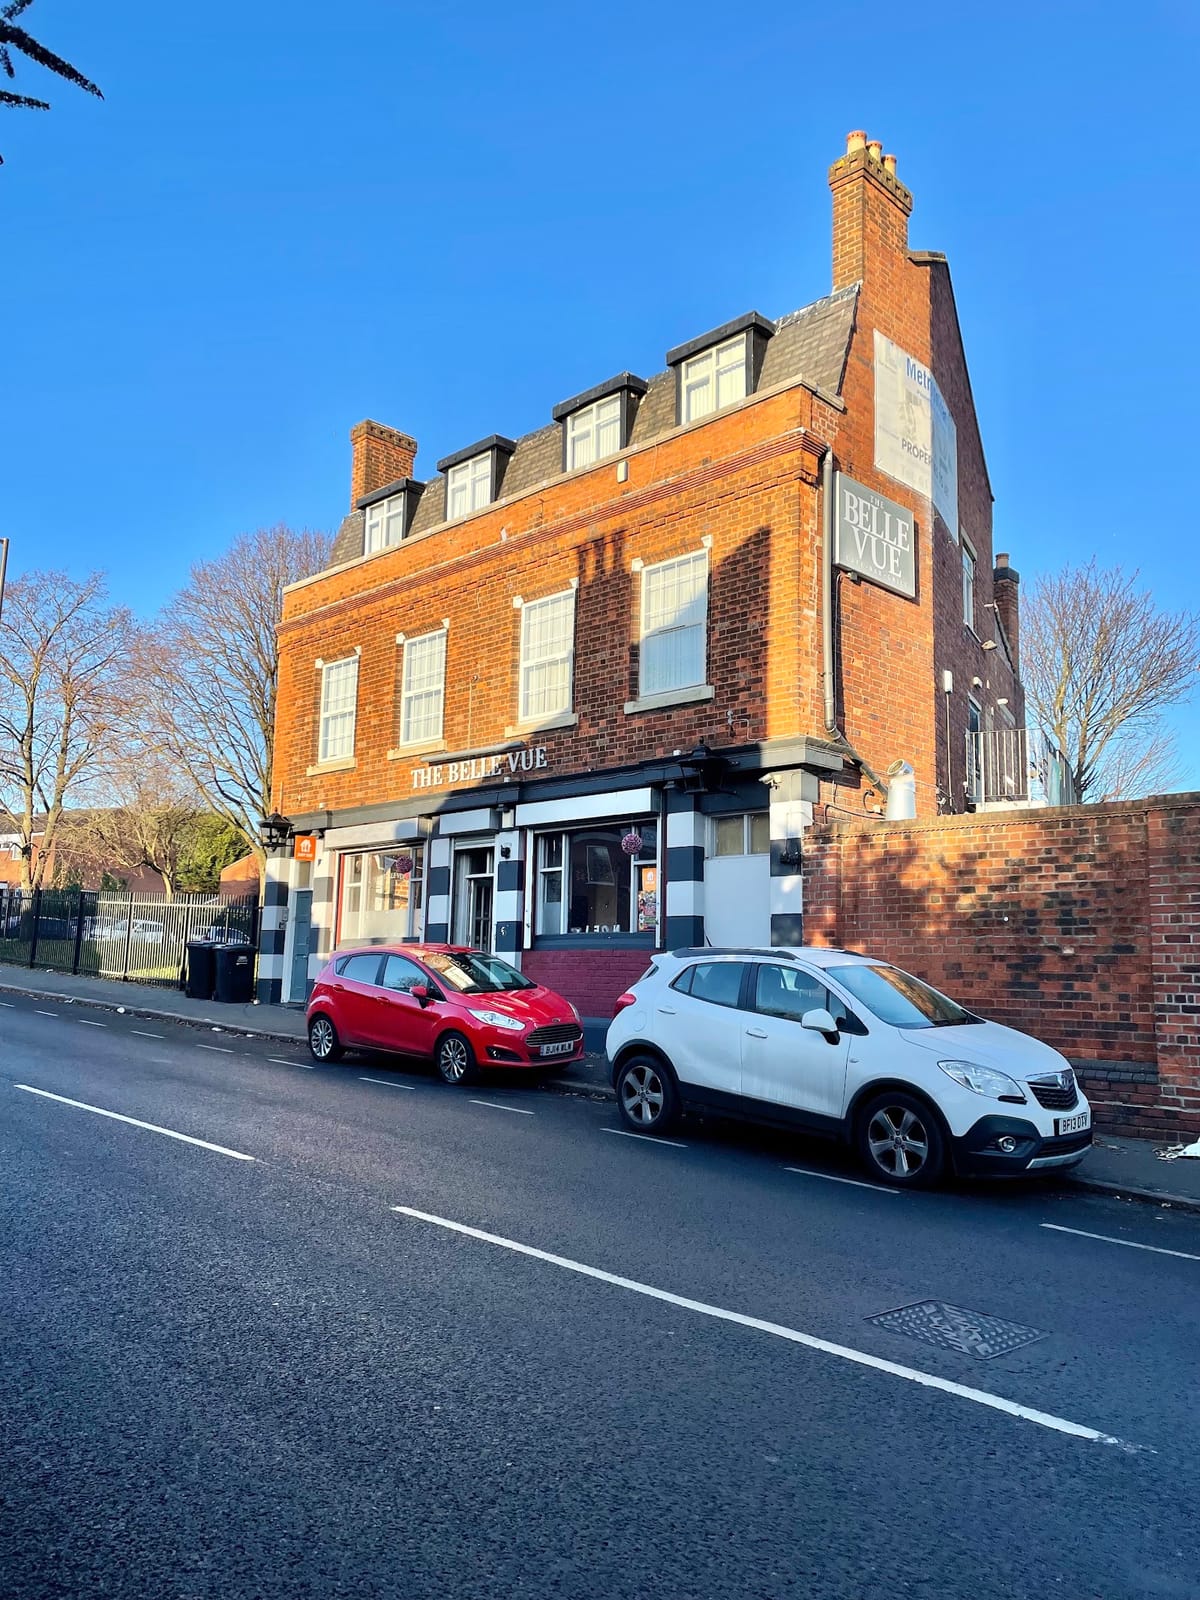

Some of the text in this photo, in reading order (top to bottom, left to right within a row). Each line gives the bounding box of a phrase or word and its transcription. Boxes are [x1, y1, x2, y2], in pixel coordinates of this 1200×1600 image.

[843, 489, 910, 552] BELLE
[870, 495, 884, 509] THE
[850, 525, 902, 578] VUE
[410, 746, 548, 789] THE BELLE VUE
[1063, 1118, 1076, 1132] BF13
